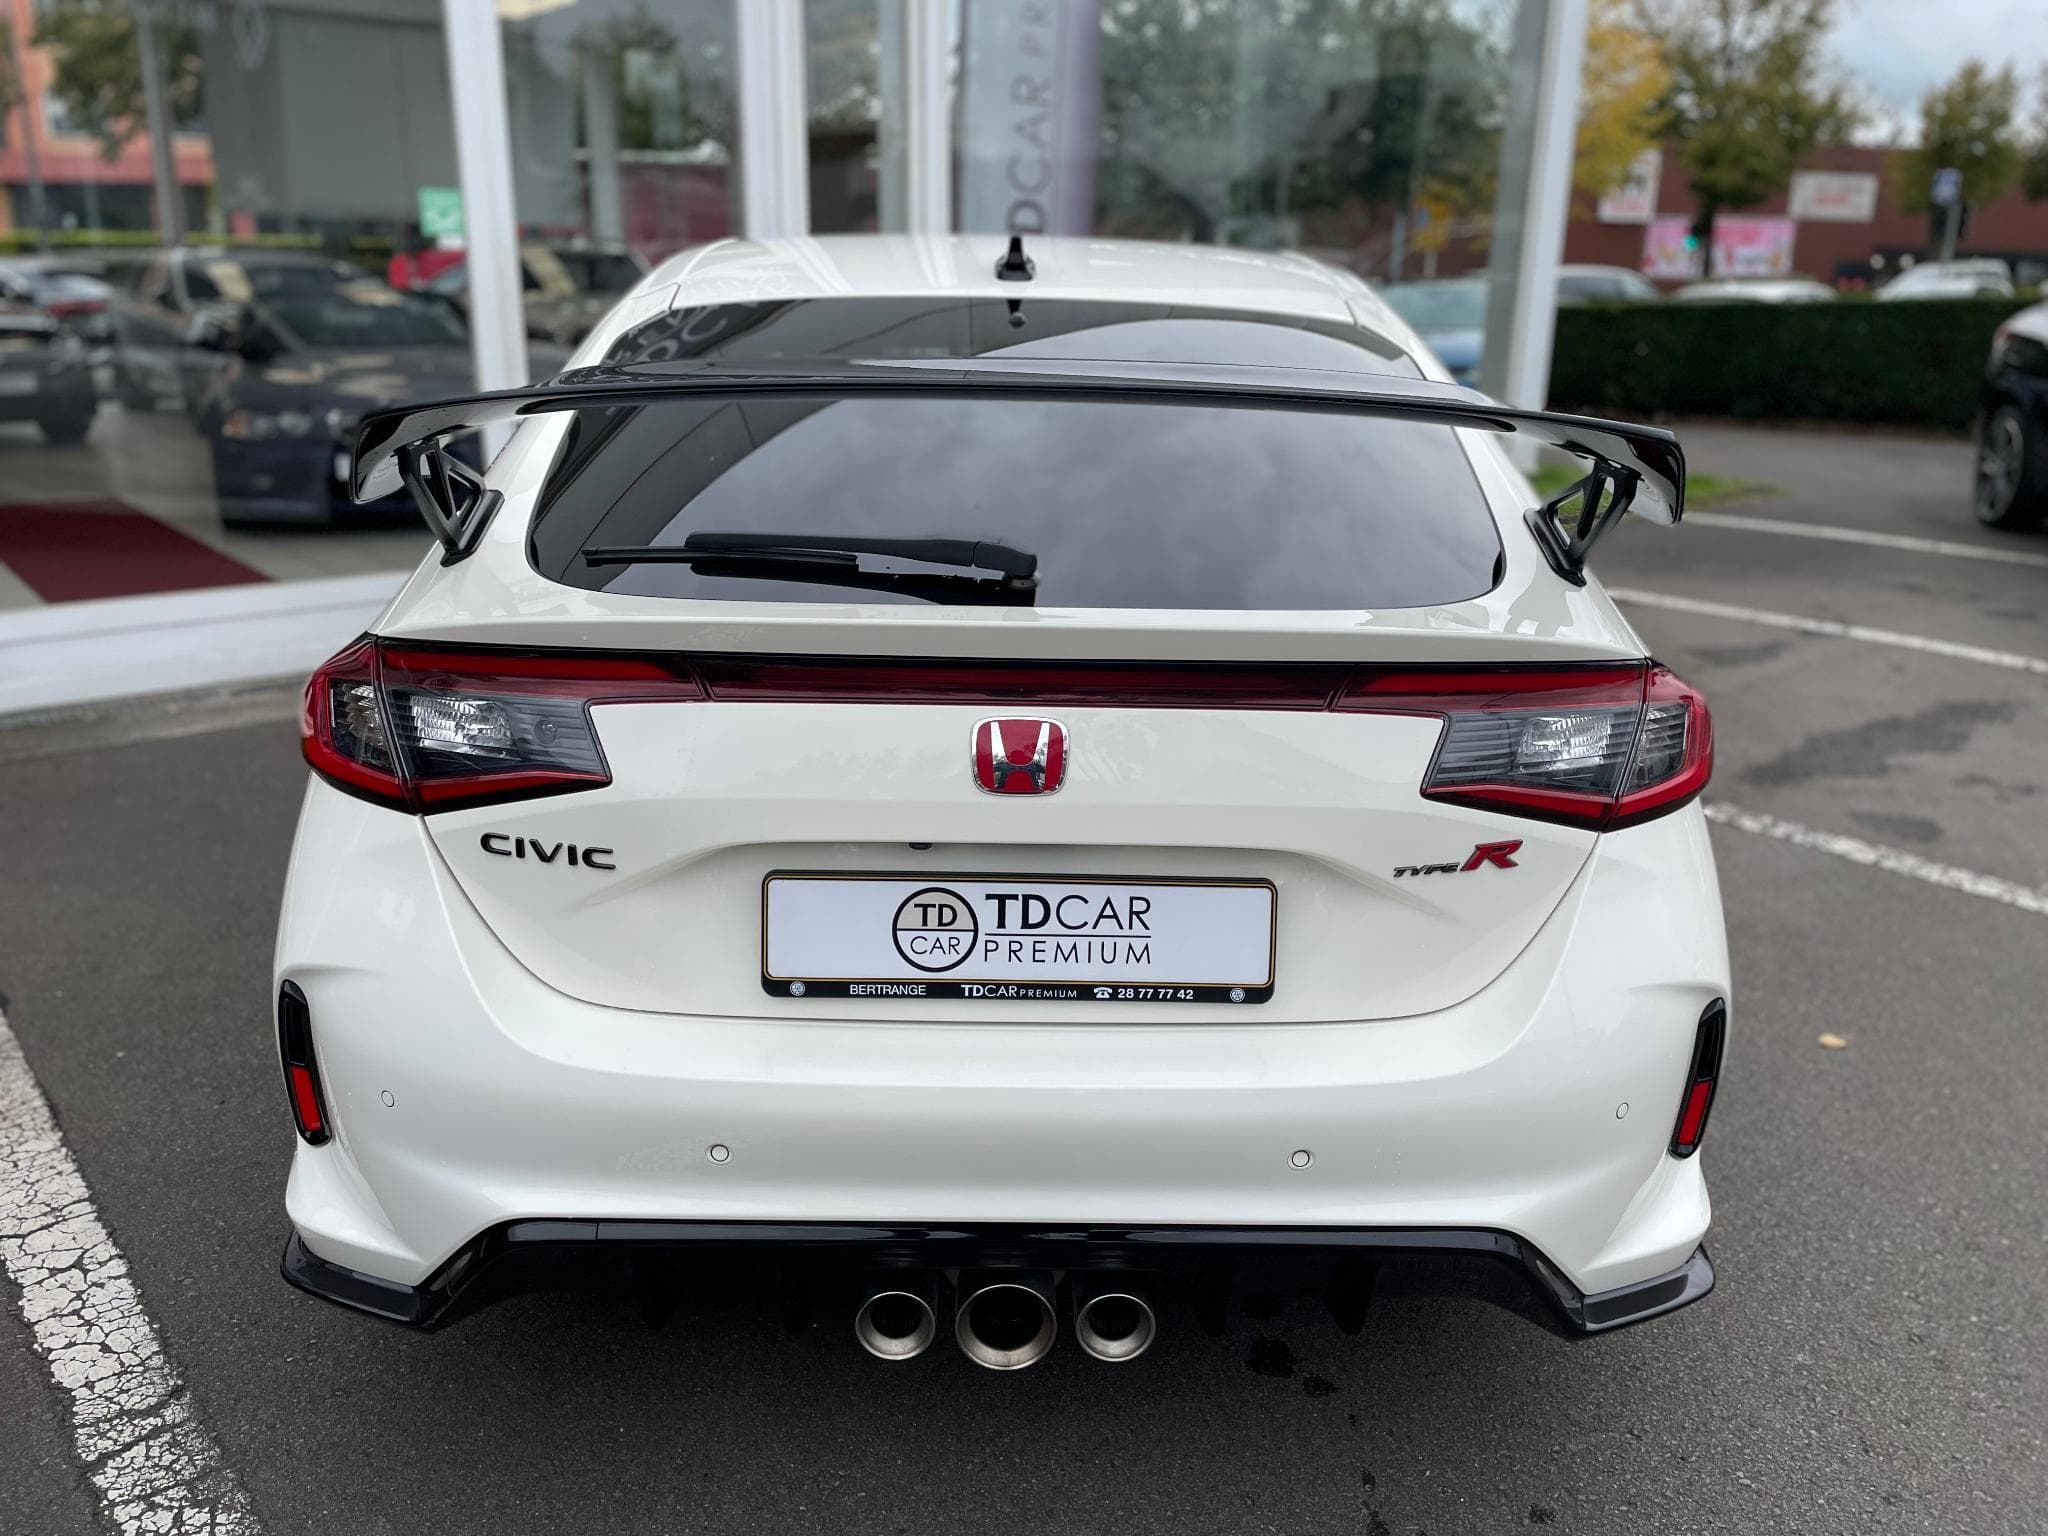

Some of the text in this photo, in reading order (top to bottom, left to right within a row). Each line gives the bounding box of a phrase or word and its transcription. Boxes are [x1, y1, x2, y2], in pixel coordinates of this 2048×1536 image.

[480, 832, 617, 870] CIVIC
[1393, 838, 1524, 878] TYPE R
[913, 903, 958, 928] TD
[984, 893, 1152, 931] TDCAR
[910, 935, 961, 955] CAR
[984, 939, 1152, 965] PREMIUM
[849, 984, 1194, 1000] BERTRANGE TDCAR PREMIUM 28 77 77 42
